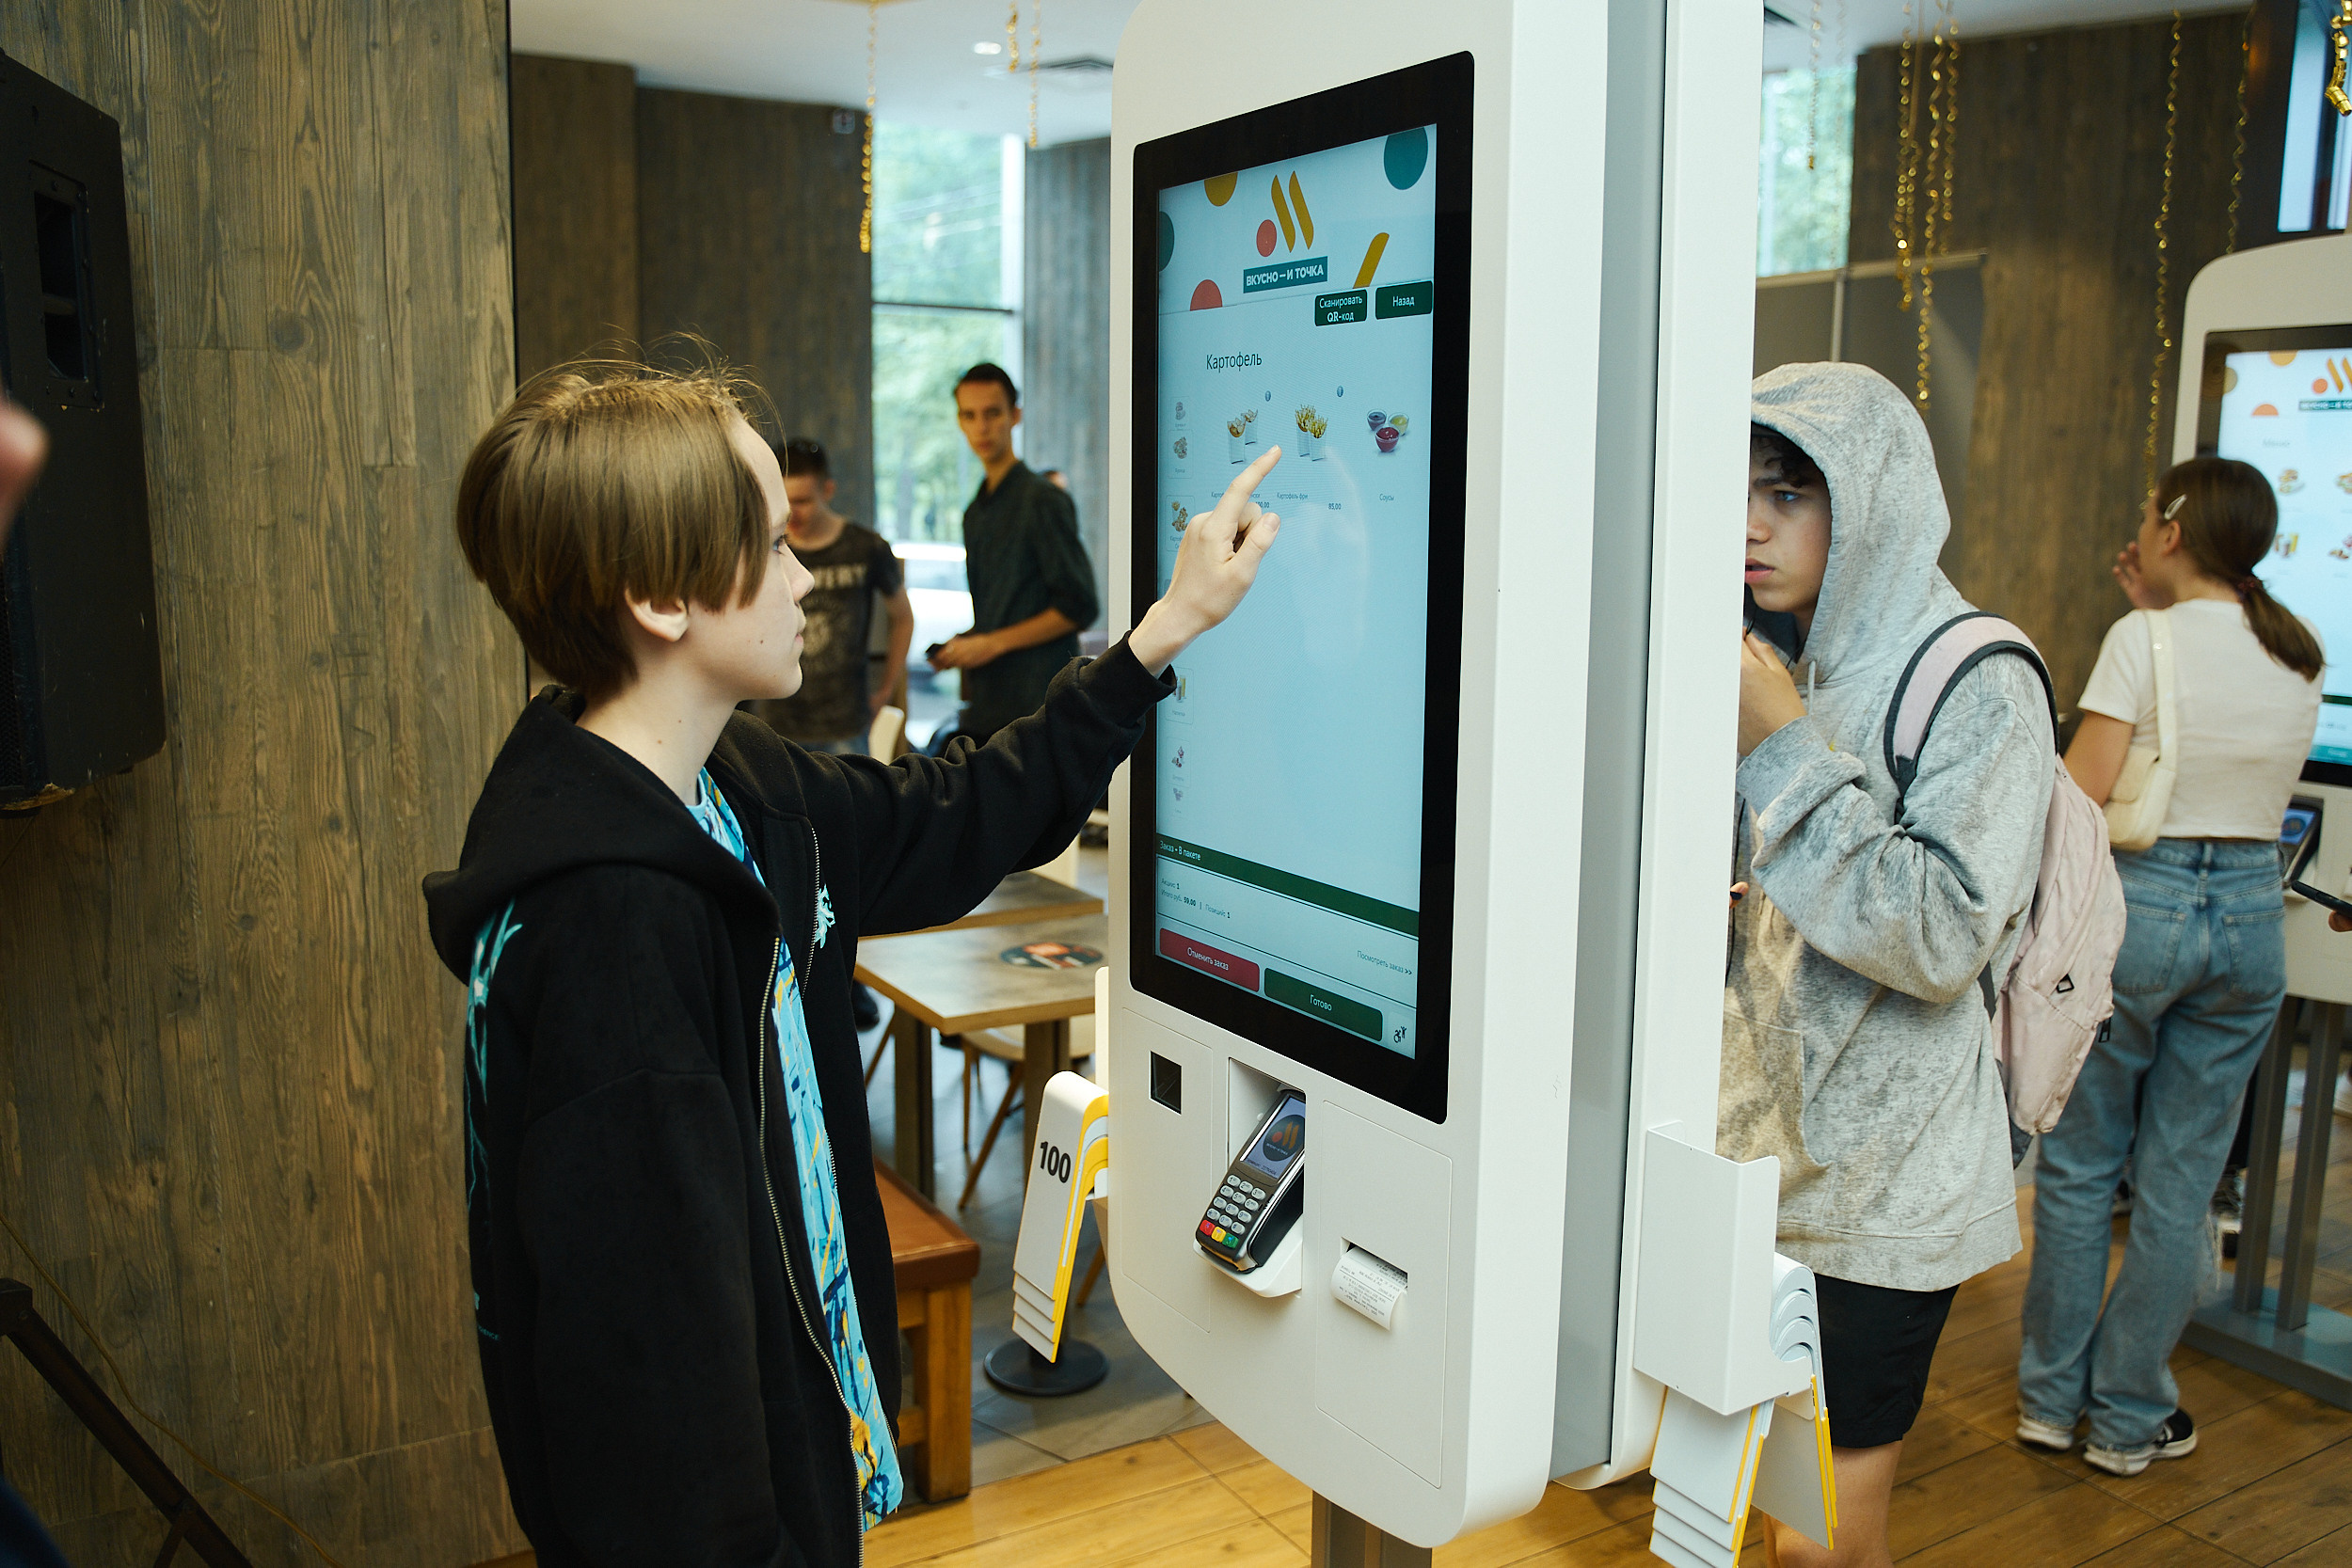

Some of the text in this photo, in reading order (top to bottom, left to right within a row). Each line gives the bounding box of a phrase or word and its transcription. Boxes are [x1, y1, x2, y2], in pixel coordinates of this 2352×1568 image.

[1246, 271, 1279, 286] ВКУСНО
[1286, 269, 1294, 280] И
[1295, 264, 1324, 279] ТОЧКА
[1319, 296, 1363, 309] Сканировать
[1392, 295, 1415, 307] Назад
[1327, 311, 1355, 323] QR-код
[1206, 351, 1263, 373] Картофель
[1160, 840, 1174, 852] Заказ
[1183, 849, 1201, 861] пакете
[1187, 946, 1229, 971] Отменить заказ
[1357, 950, 1389, 967] Посмотреть
[1310, 993, 1332, 1011] Готово
[1040, 1141, 1072, 1183] 100
